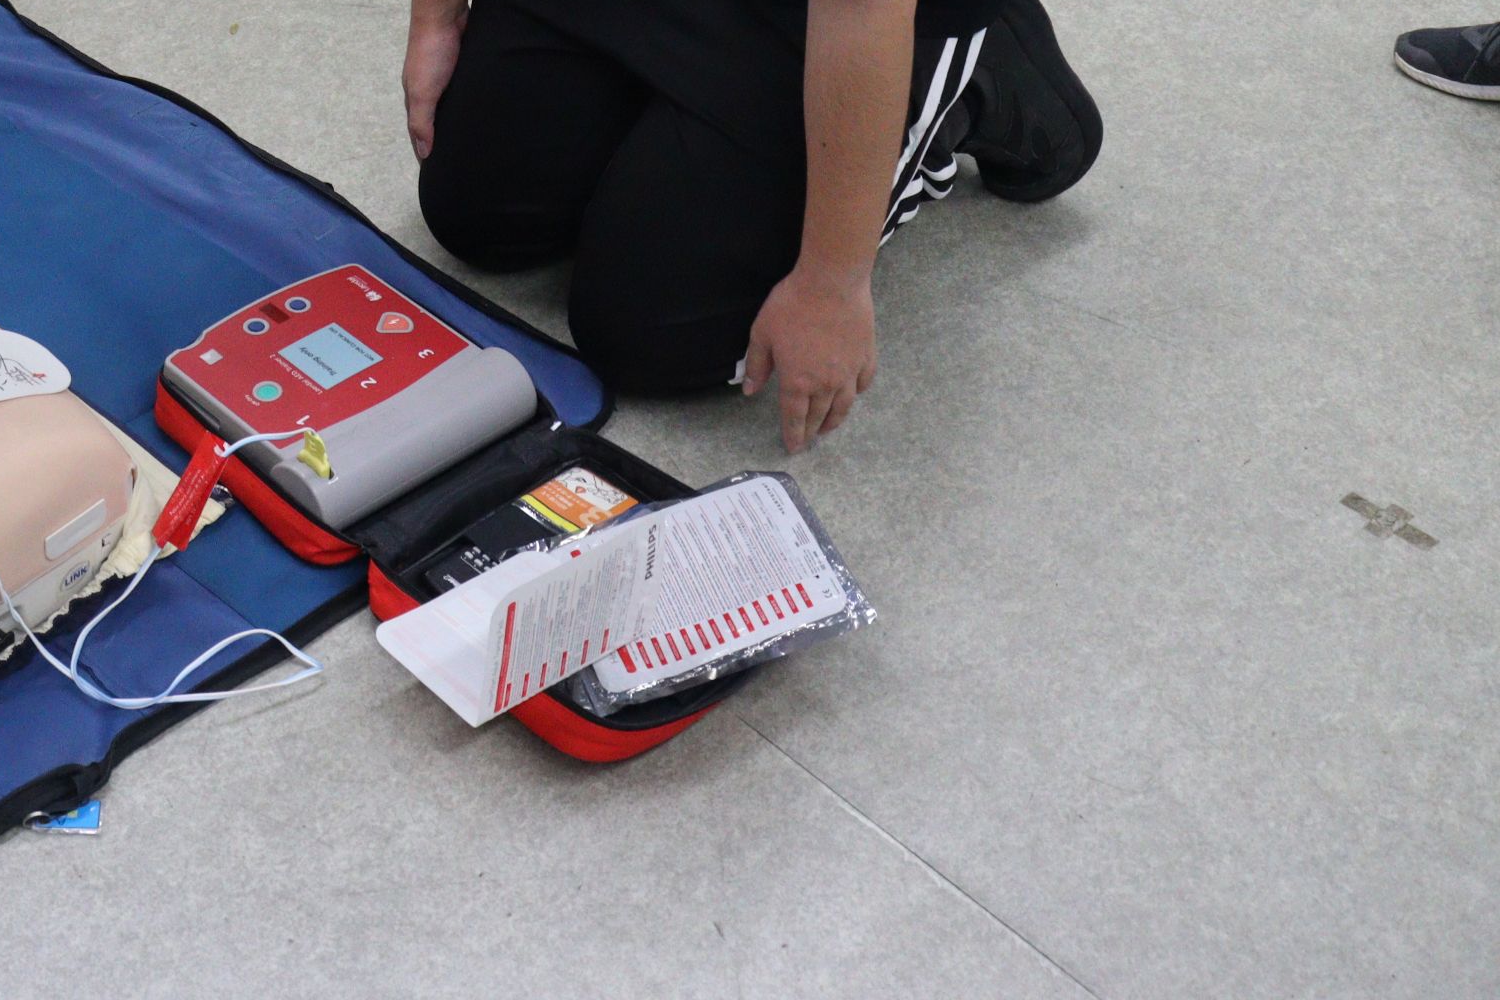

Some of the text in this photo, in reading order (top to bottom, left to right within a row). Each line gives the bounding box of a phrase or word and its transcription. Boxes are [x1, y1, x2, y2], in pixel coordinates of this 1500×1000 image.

[418, 348, 435, 359] 3
[313, 355, 337, 376] Training
[360, 377, 377, 389] 2
[296, 414, 310, 425] 1
[644, 523, 657, 581] PHILIPS
[64, 565, 88, 587] LINK
